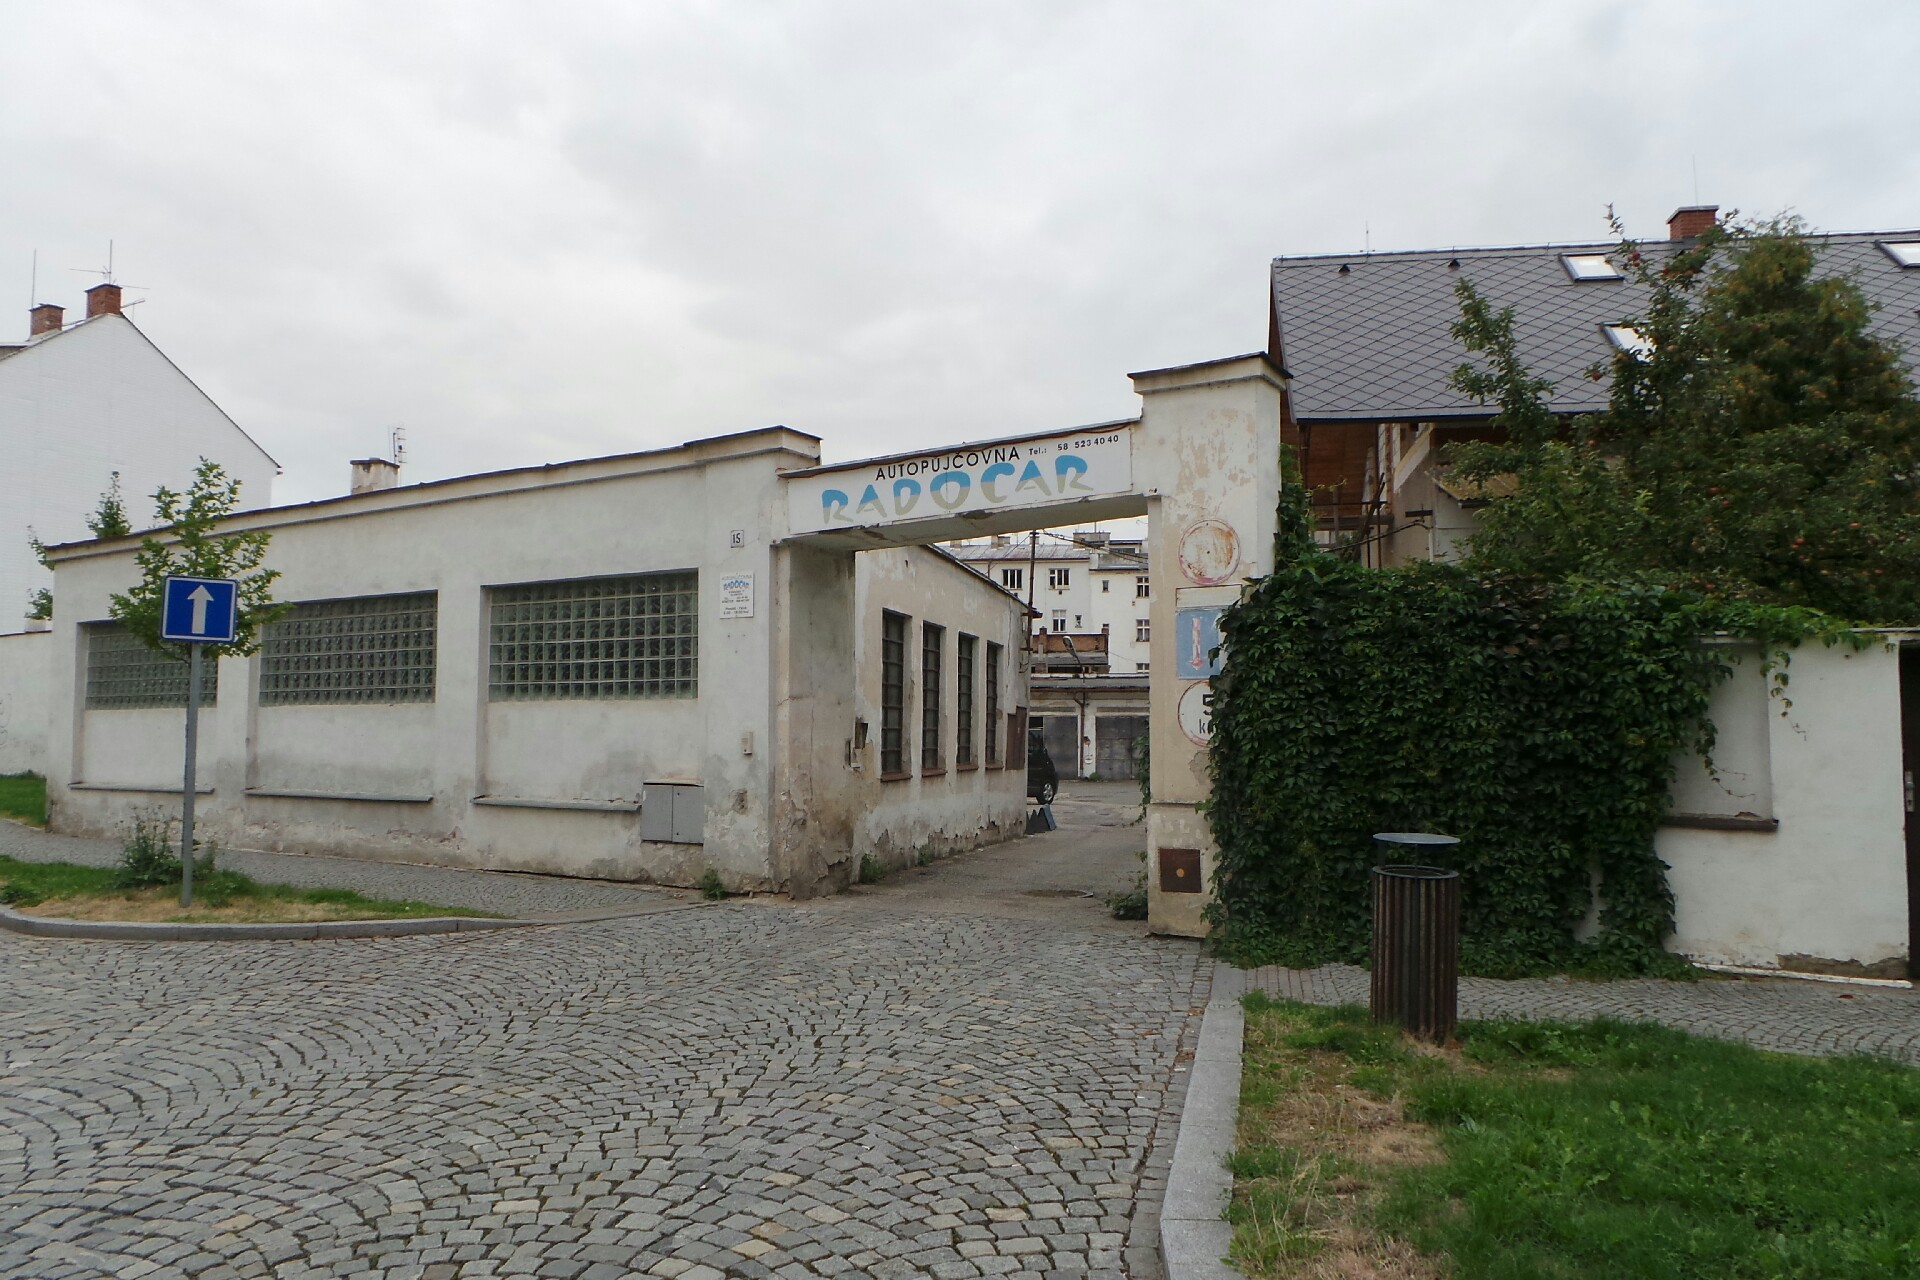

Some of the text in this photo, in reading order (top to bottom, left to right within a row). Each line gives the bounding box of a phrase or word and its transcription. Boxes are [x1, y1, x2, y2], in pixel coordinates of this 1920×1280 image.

[1057, 442, 1069, 451] 58
[821, 454, 1094, 525] RADOCAR
[732, 532, 741, 544] 15
